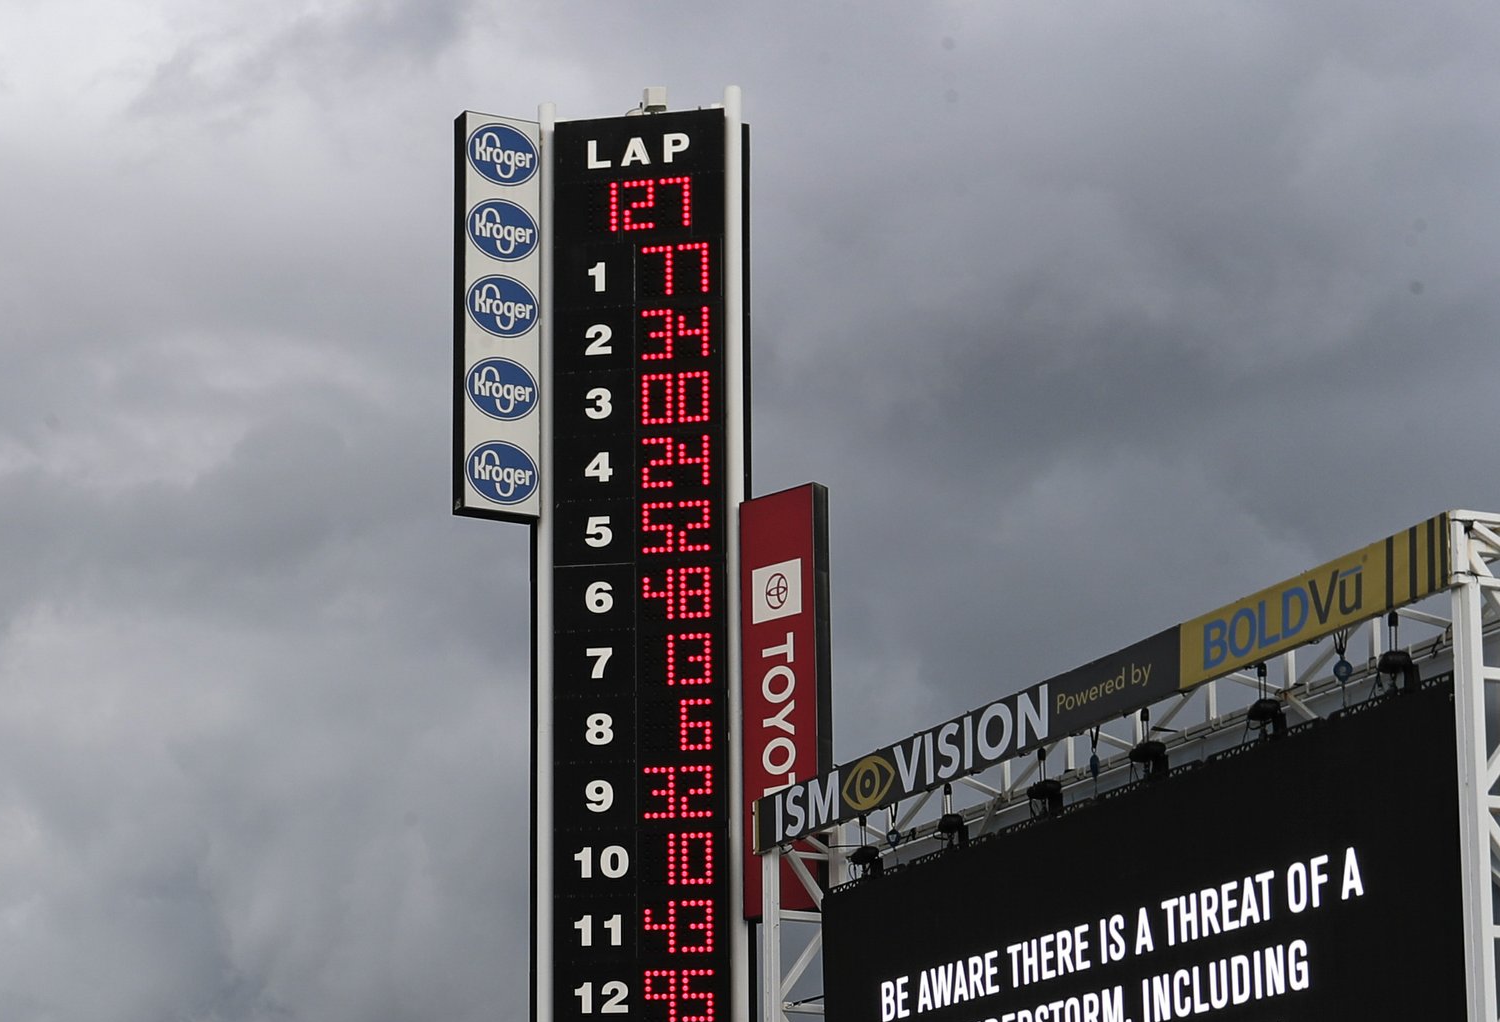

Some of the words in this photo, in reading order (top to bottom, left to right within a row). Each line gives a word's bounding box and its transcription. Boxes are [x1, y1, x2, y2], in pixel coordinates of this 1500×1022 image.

[475, 132, 533, 179] Kroger
[587, 132, 690, 169] LAP
[475, 207, 533, 254] Kroger
[610, 176, 691, 232] 127
[588, 262, 606, 291] 1
[642, 242, 709, 295] 77
[475, 283, 533, 331] Kroger
[585, 325, 612, 355] 2
[642, 306, 709, 360] 34
[474, 366, 532, 413] Kroger
[585, 388, 612, 419] 3
[642, 371, 710, 425] 00
[474, 450, 532, 497] Kroger
[585, 452, 613, 481] 4
[642, 435, 710, 488] 24
[585, 516, 613, 547] 5
[642, 500, 711, 554] 52
[585, 582, 613, 613] 6
[642, 566, 711, 619] 48
[586, 648, 613, 678] 7
[667, 633, 712, 685] 13
[585, 713, 613, 745] 8
[680, 698, 712, 751] 6
[775, 770, 839, 843] ISM
[893, 683, 1049, 793] VISION
[1056, 667, 1125, 714] Powered
[1132, 663, 1151, 687] by
[585, 780, 613, 812] 9
[644, 765, 712, 819] 32
[574, 846, 629, 878] 10
[668, 832, 713, 885] 10
[574, 915, 622, 946] 11
[644, 900, 714, 953] 43
[881, 976, 910, 1022] BE
[918, 950, 999, 1013] AWARE
[1007, 924, 1090, 988] THERE
[1100, 914, 1125, 964] IS
[1135, 907, 1153, 955] A
[1161, 870, 1274, 946] THREAT
[1287, 855, 1328, 913] OF
[1342, 847, 1364, 900] A
[574, 981, 629, 1013] 12
[644, 969, 714, 1022] 95
